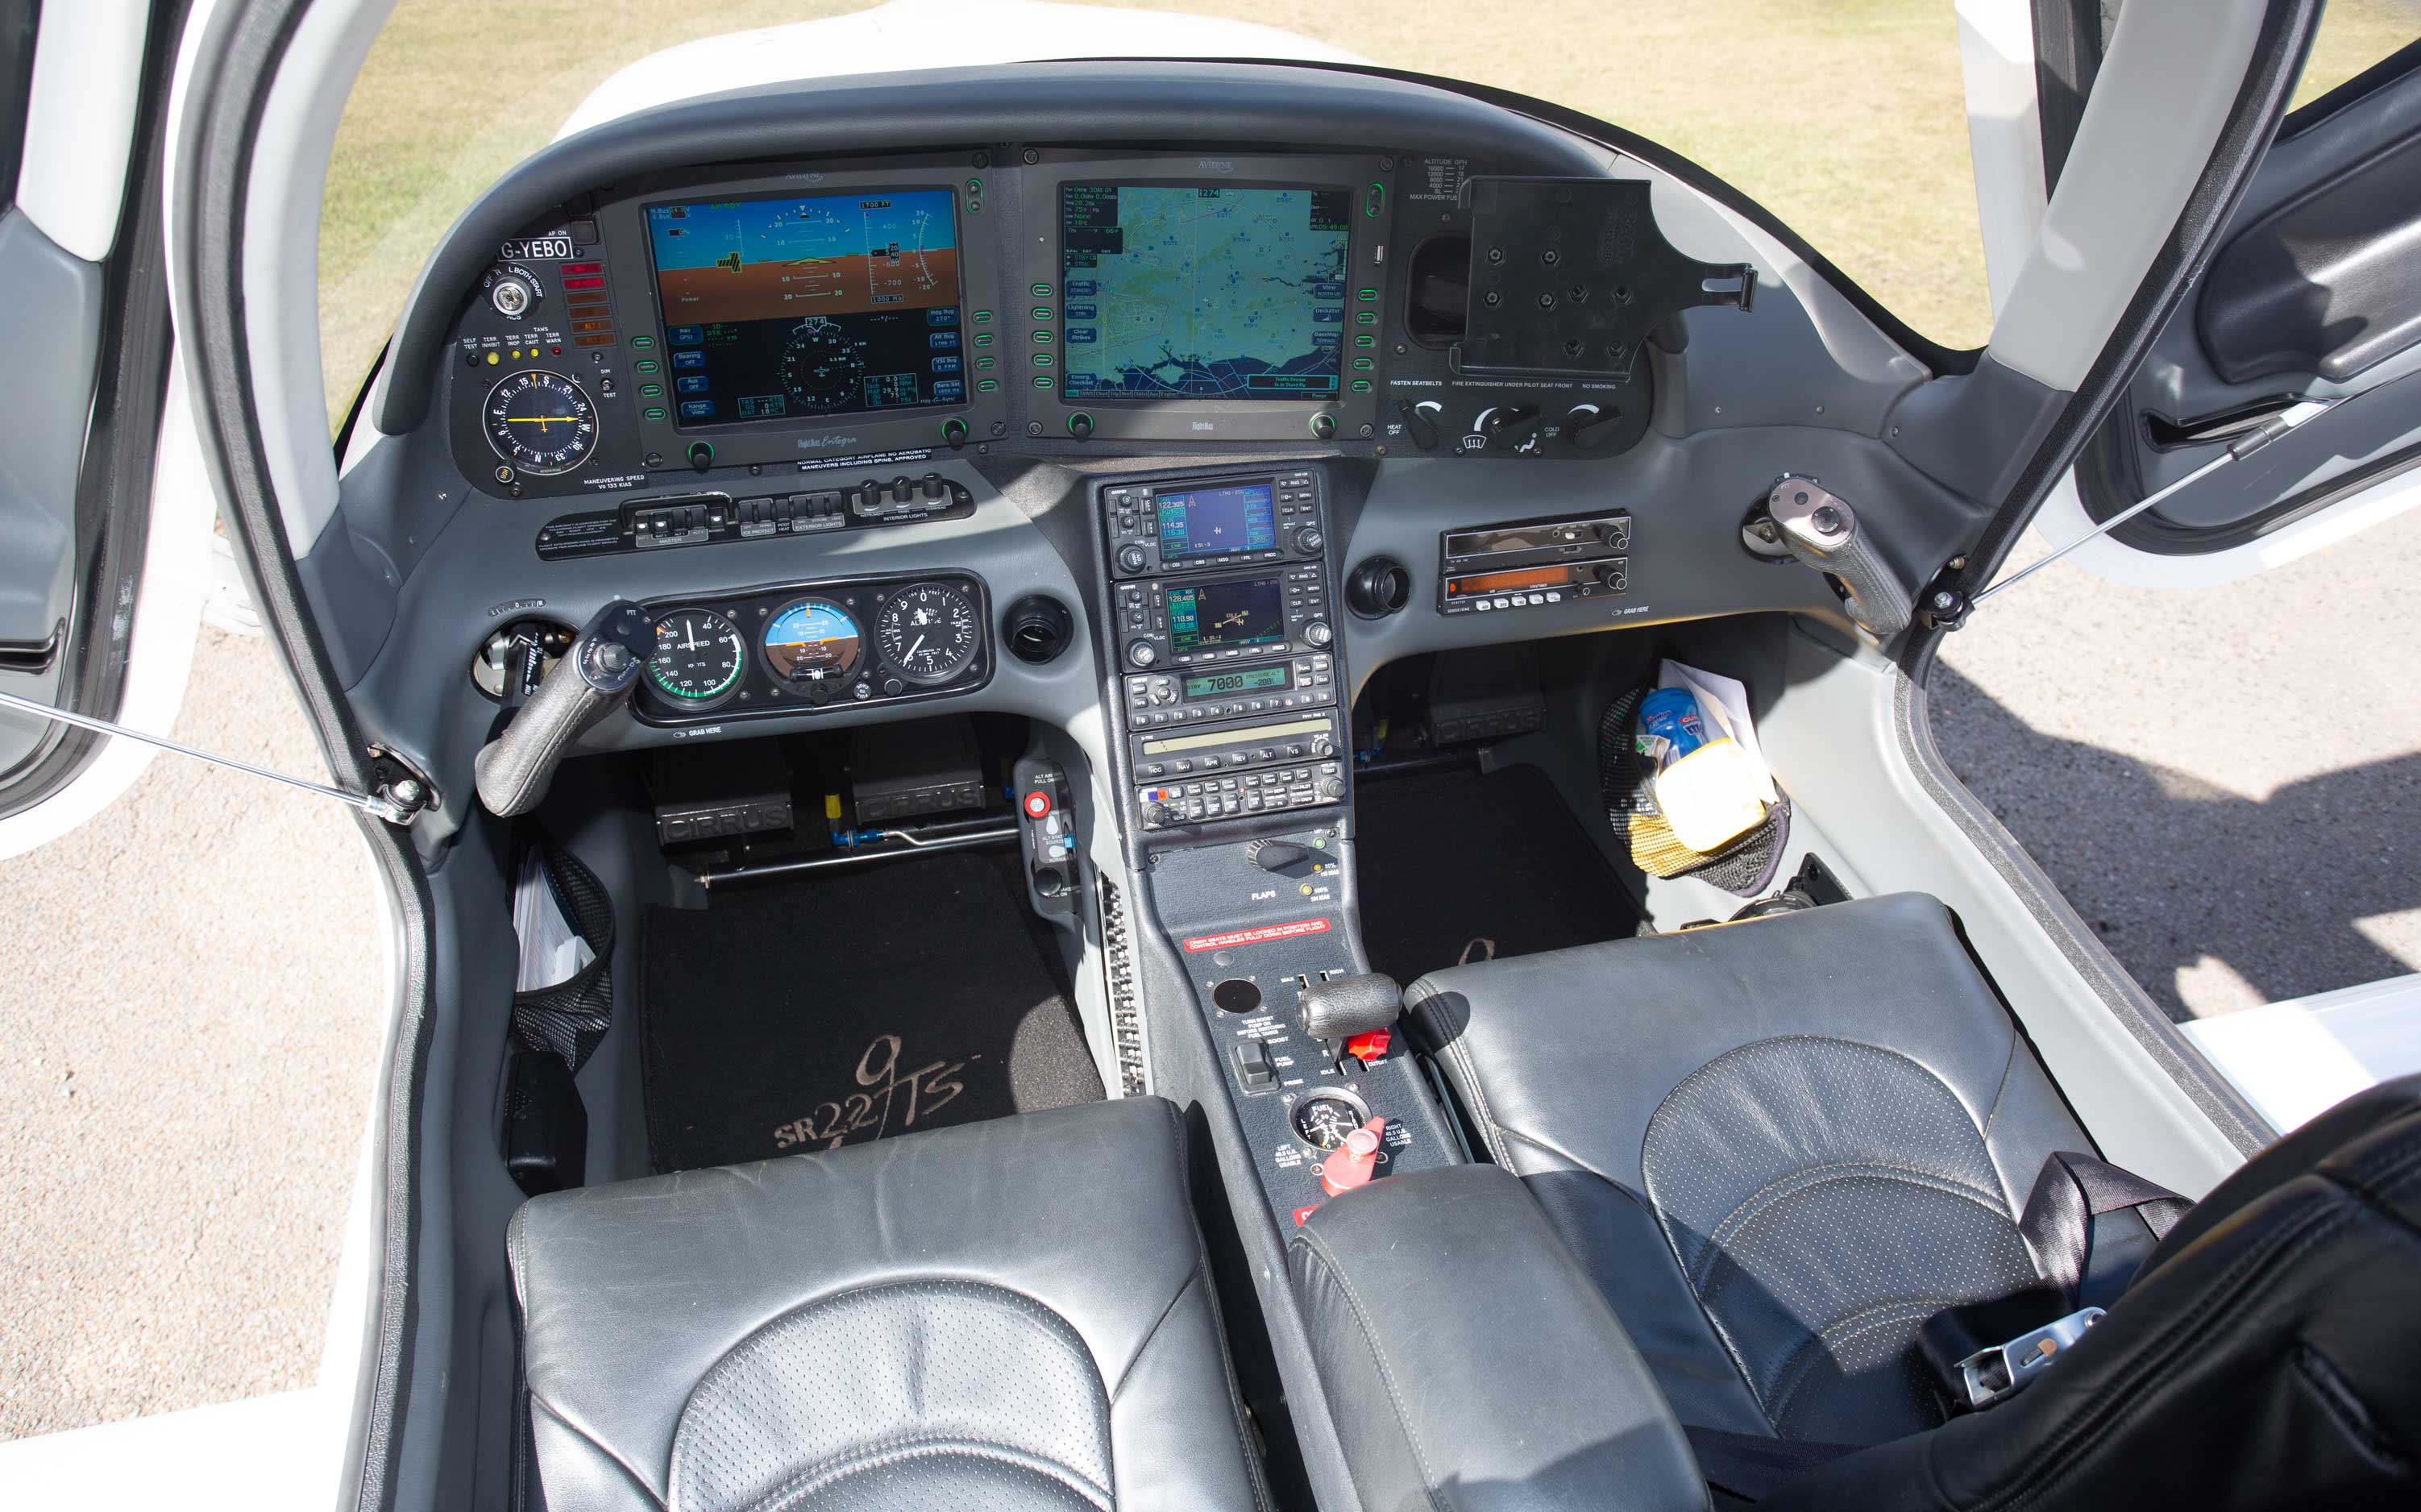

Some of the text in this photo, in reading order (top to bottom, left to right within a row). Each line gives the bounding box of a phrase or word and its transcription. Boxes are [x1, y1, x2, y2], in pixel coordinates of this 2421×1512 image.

[501, 241, 567, 258] G-YEBO
[484, 276, 493, 288] OFF
[514, 268, 532, 280] BOTH
[530, 275, 542, 298] START
[824, 455, 856, 463] CATEGORY
[584, 476, 624, 484] MANEUVERING
[920, 593, 927, 601] 0
[943, 597, 945, 606] 1
[901, 601, 907, 610] 9
[892, 613, 898, 621] 8
[953, 609, 959, 617] 2
[956, 634, 961, 642] 3
[895, 642, 901, 651] 7
[946, 648, 953, 656] 4
[927, 656, 933, 664] 5
[1207, 676, 1242, 692] 7000
[863, 787, 978, 819] CIRRUS
[667, 806, 785, 841] CIRRUS
[1252, 891, 1276, 900] FLAPS
[1219, 938, 1244, 946] HANDLES
[1258, 1024, 1285, 1032] SWITCHING
[1368, 1059, 1387, 1067] CUTOFF
[1312, 1103, 1332, 1112] FUEL
[774, 1092, 878, 1149] SR22
[1386, 1133, 1411, 1142] GALLONS
[1389, 1138, 1412, 1147] USABLE
[1275, 1154, 1301, 1163] GALLONS
[1279, 1160, 1302, 1168] USABLE
